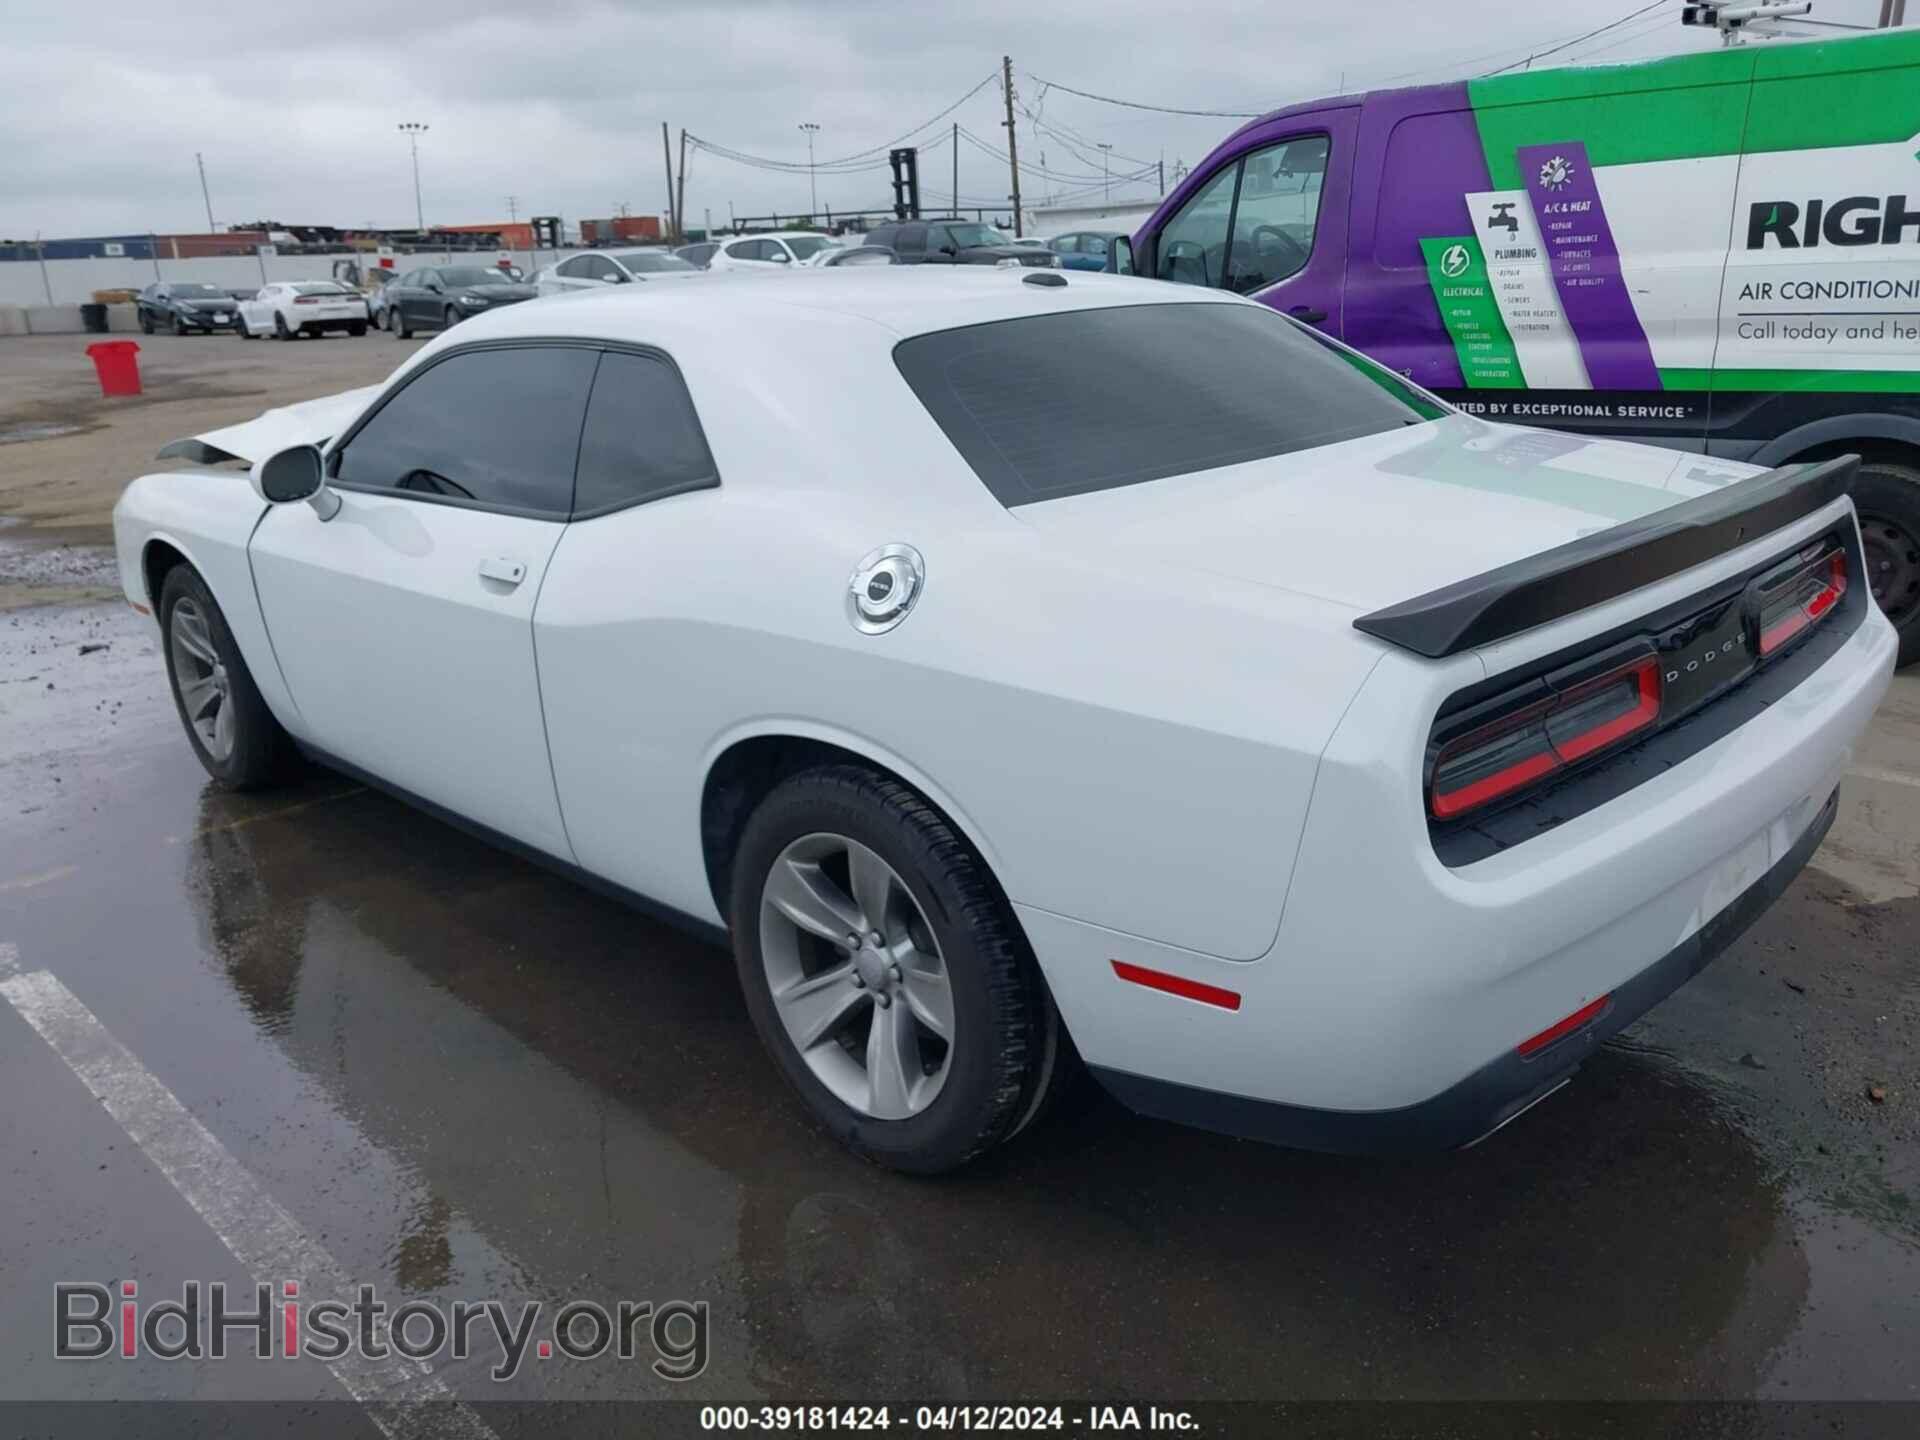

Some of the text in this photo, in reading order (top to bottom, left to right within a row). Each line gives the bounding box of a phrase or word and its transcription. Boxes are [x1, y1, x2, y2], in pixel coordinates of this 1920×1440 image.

[1544, 201, 1591, 214] A/C & HEAT
[1747, 195, 1920, 250] RIGH
[1495, 248, 1537, 259] PLUMBING
[1443, 287, 1483, 297] ELECTRICAL
[1739, 283, 1772, 300] AIR
[1738, 320, 1920, 344] Call today and he
[1490, 403, 1508, 415] BY
[1513, 403, 1612, 417] EXCEPTIONAL
[1618, 405, 1684, 418] SERVICE
[1666, 632, 1745, 682] DODGE
